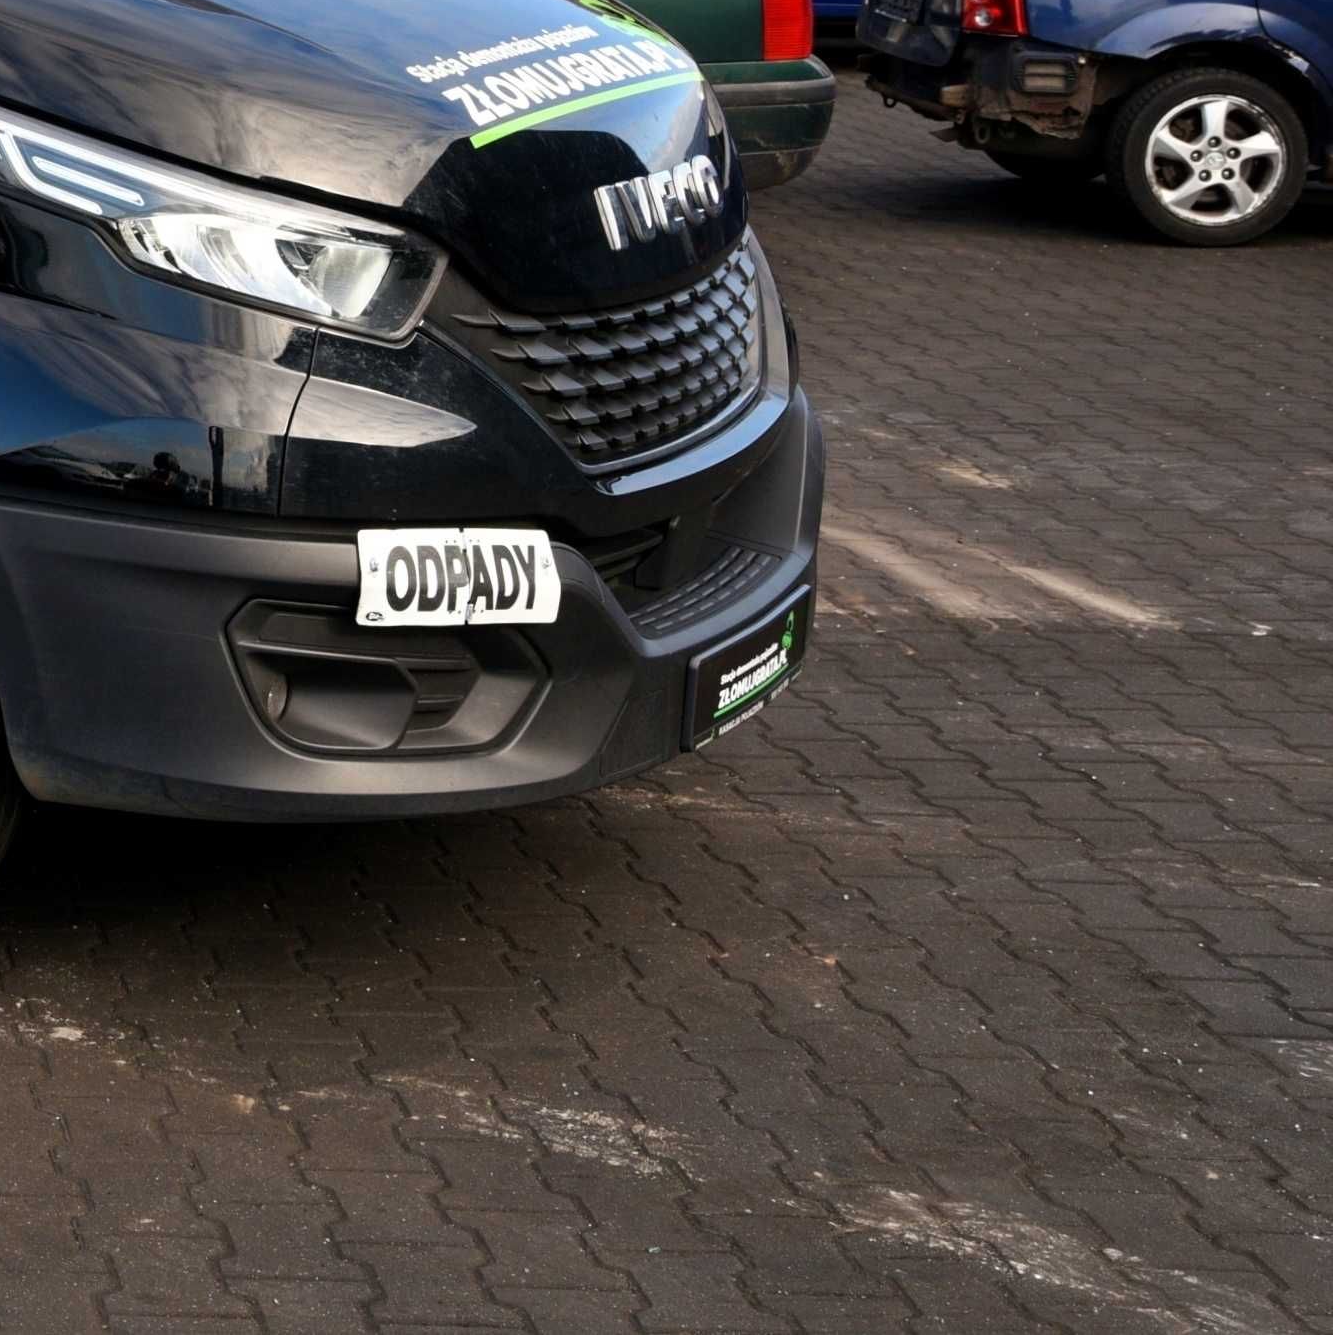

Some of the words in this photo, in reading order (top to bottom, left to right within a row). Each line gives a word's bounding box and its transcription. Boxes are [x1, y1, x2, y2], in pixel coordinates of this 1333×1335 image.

[405, 55, 469, 83] Stacja
[442, 39, 688, 126] ZŁOMUJGRATA.PL
[594, 155, 724, 251] IVECO
[386, 545, 535, 612] ODPADY
